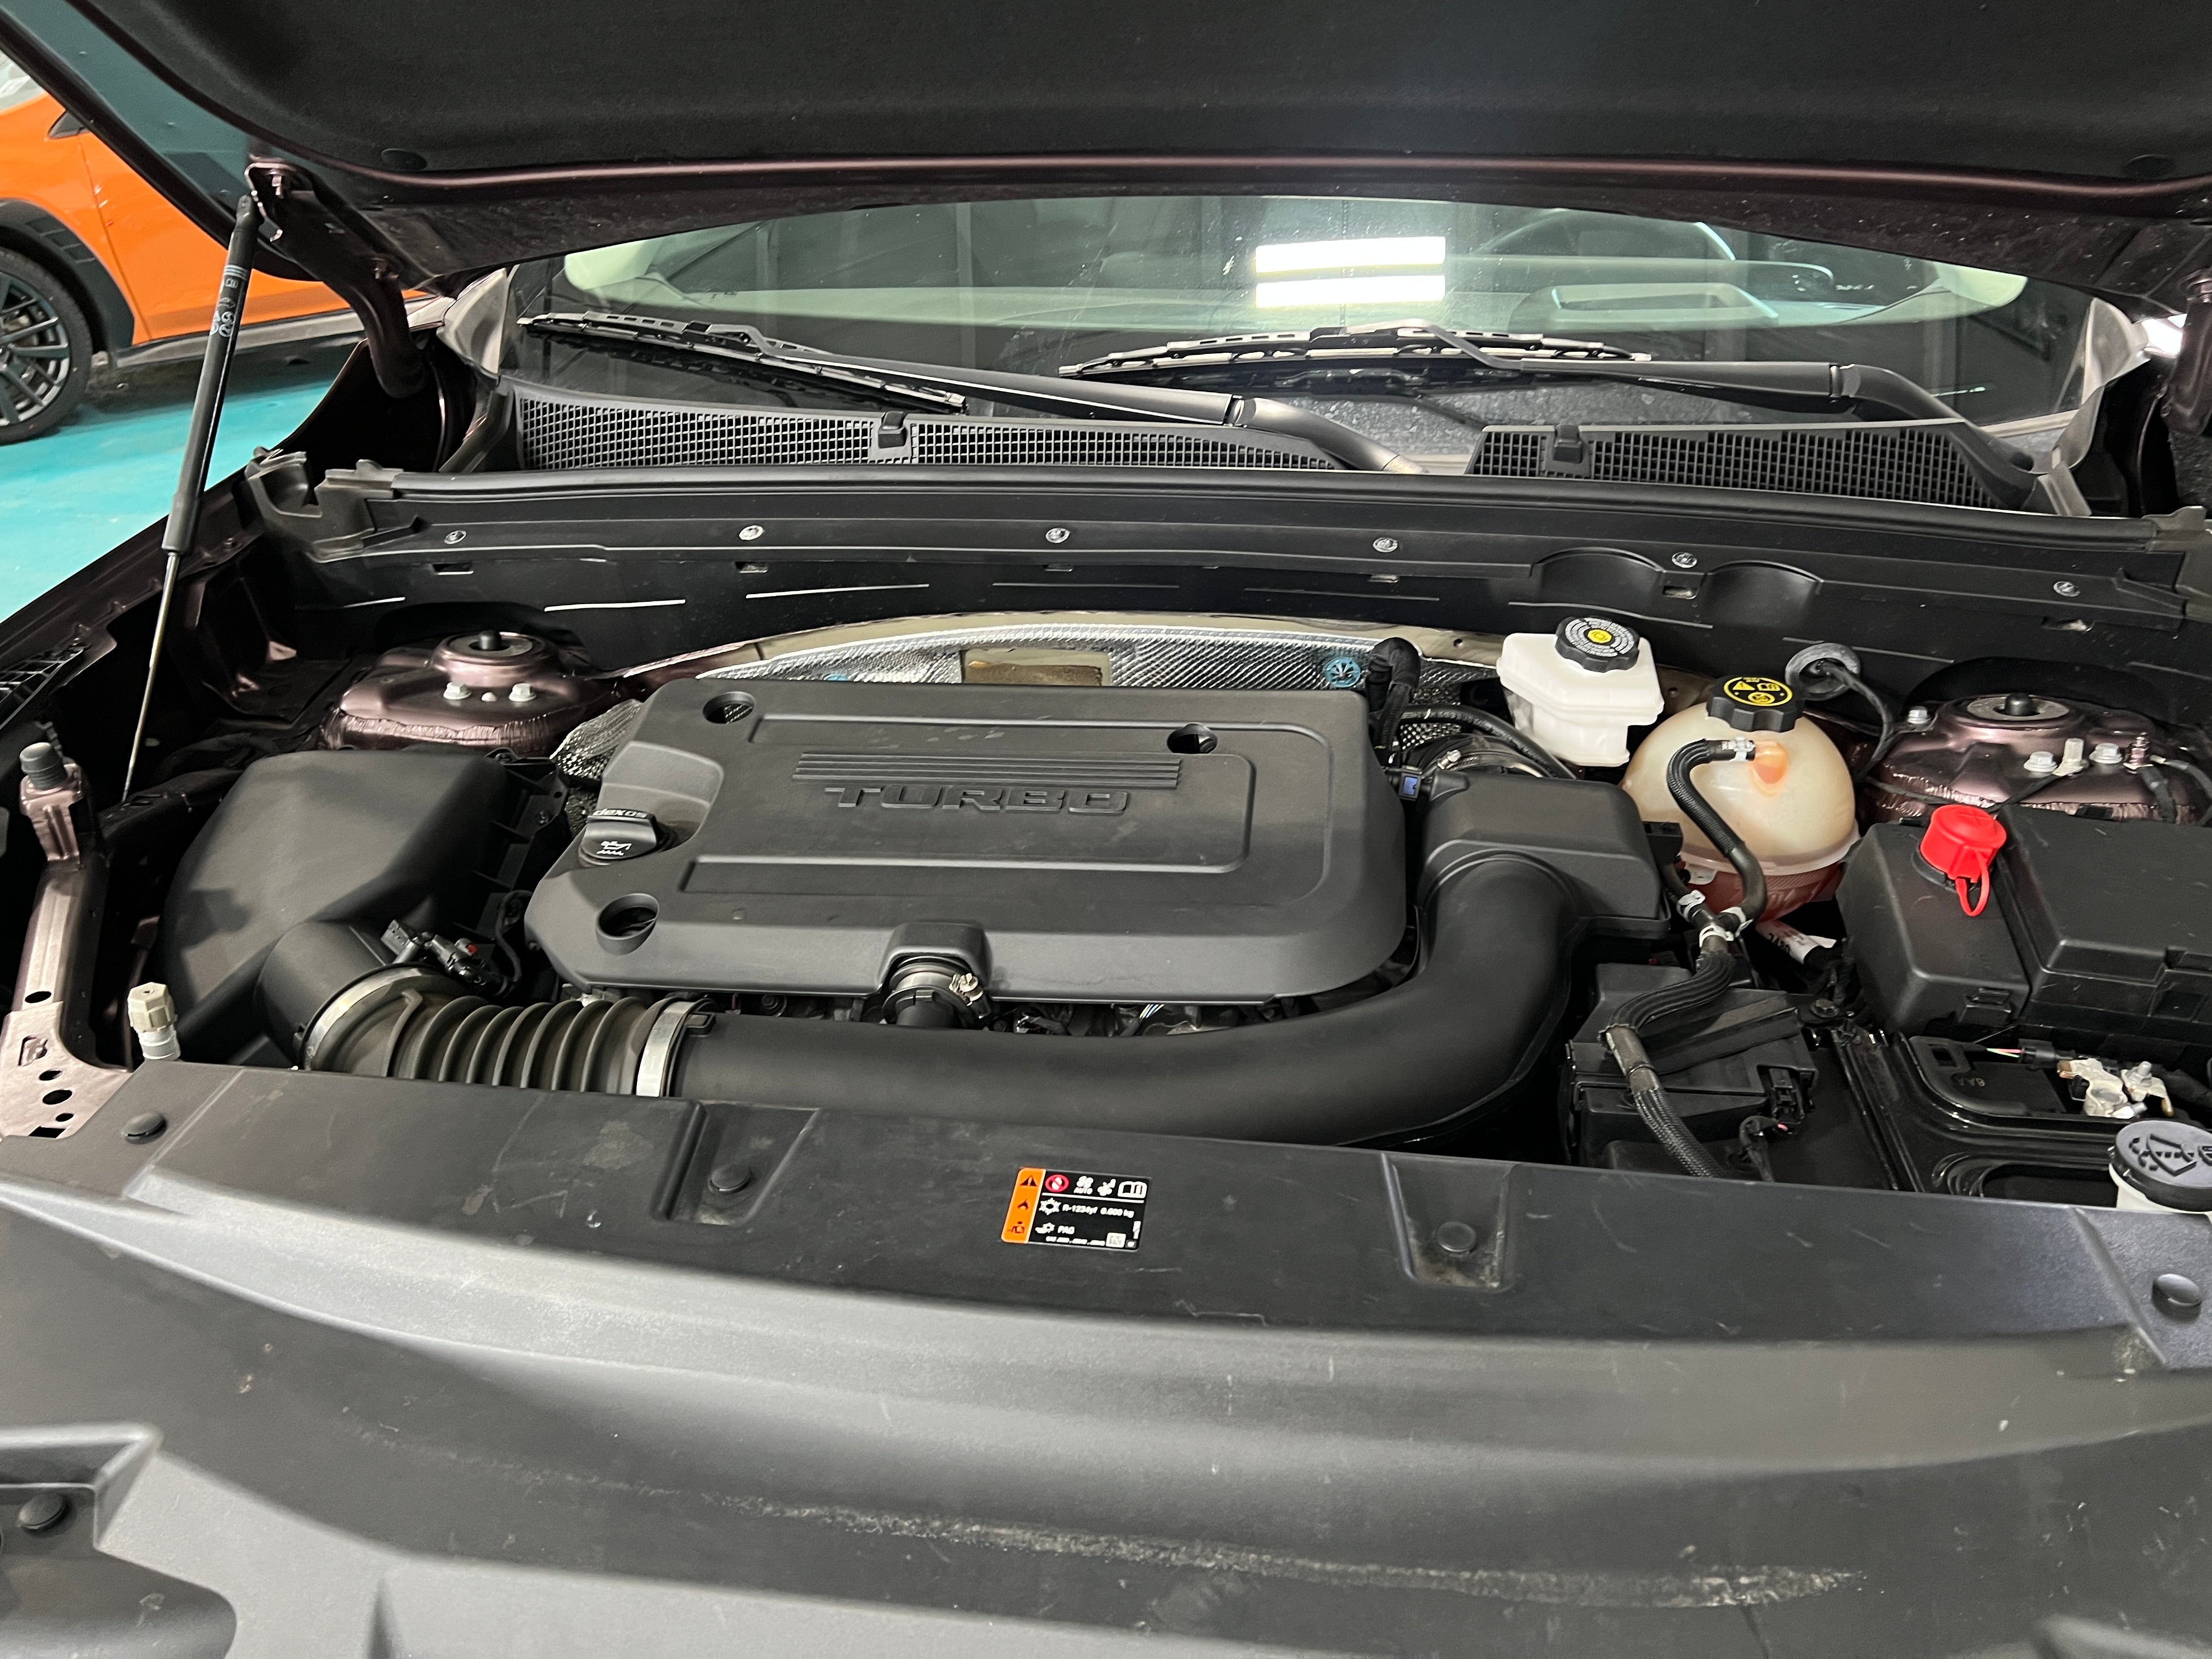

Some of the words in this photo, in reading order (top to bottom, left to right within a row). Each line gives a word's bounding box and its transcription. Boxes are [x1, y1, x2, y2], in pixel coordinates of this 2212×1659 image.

[825, 785, 1128, 814] TURBO
[592, 808, 648, 818] dexos
[1058, 1226, 1075, 1234] PAG
